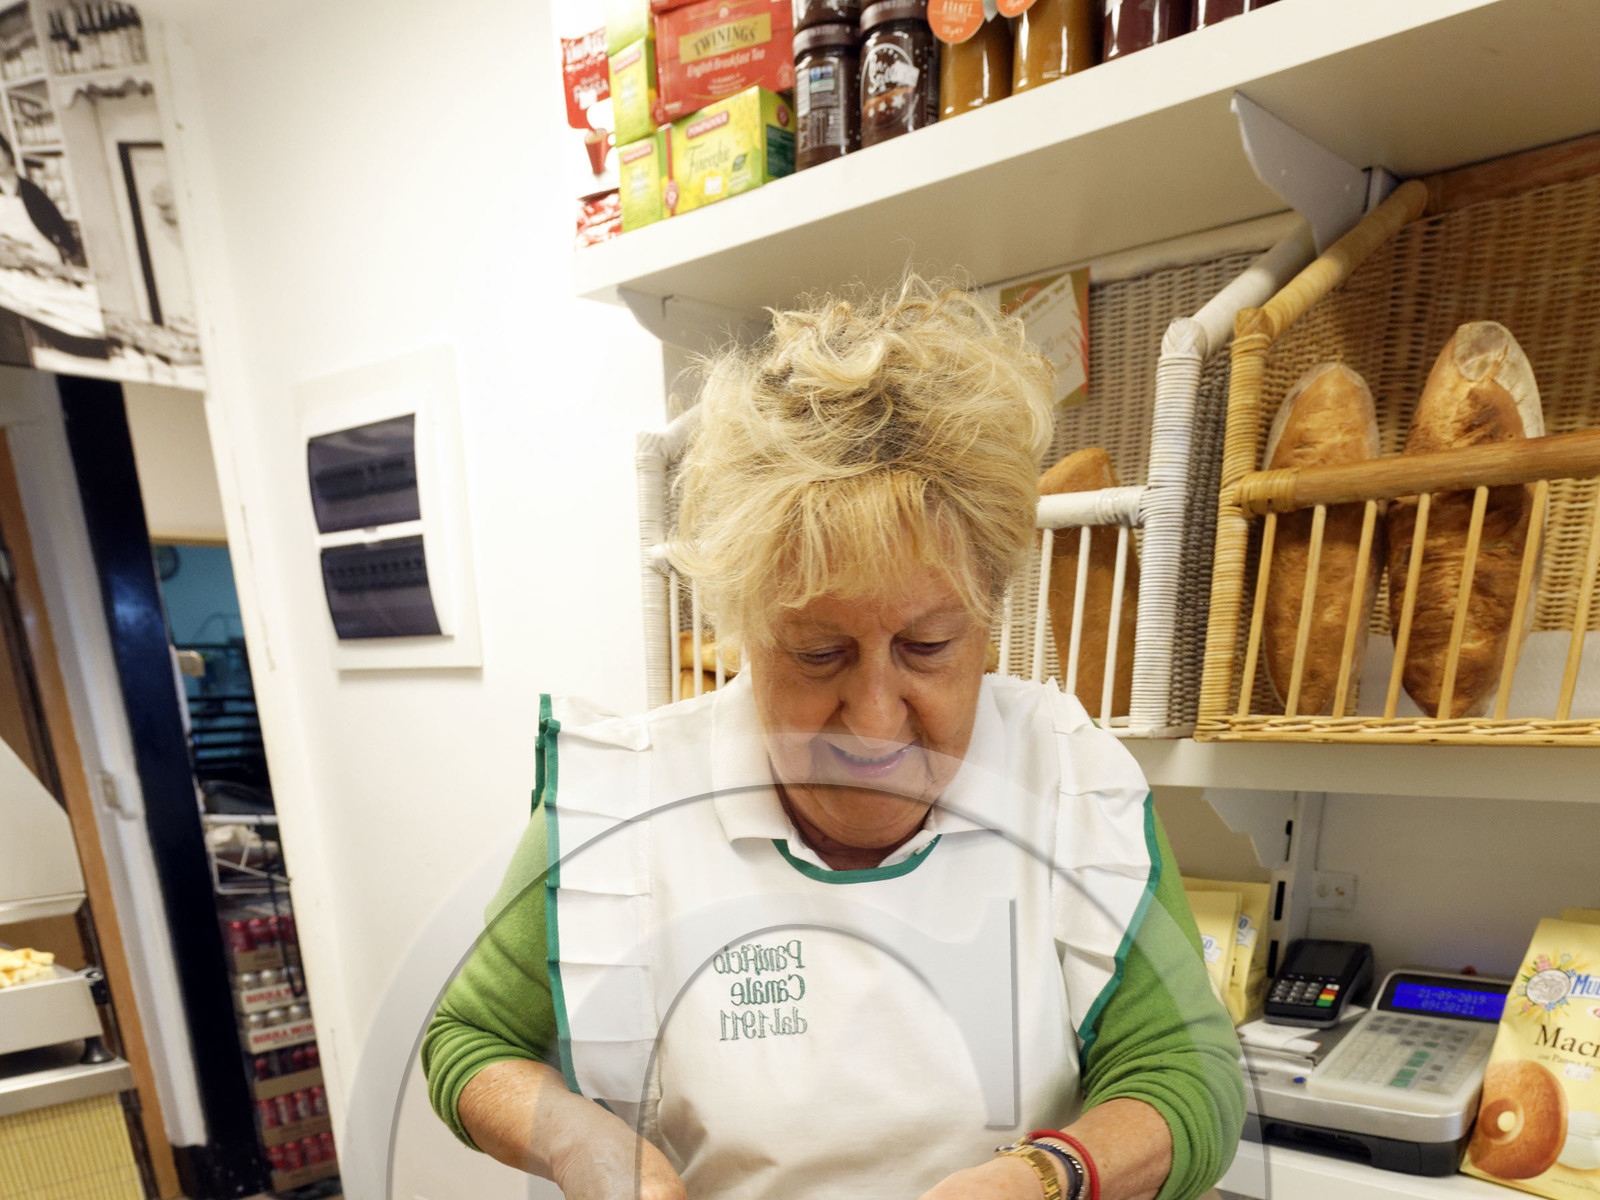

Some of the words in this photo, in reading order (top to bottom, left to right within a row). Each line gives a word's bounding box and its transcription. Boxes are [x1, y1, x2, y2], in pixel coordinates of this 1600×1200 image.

[693, 24, 757, 56] TWININGS
[686, 60, 713, 78] English
[713, 53, 750, 71] Breakfast
[751, 48, 767, 61] Tea
